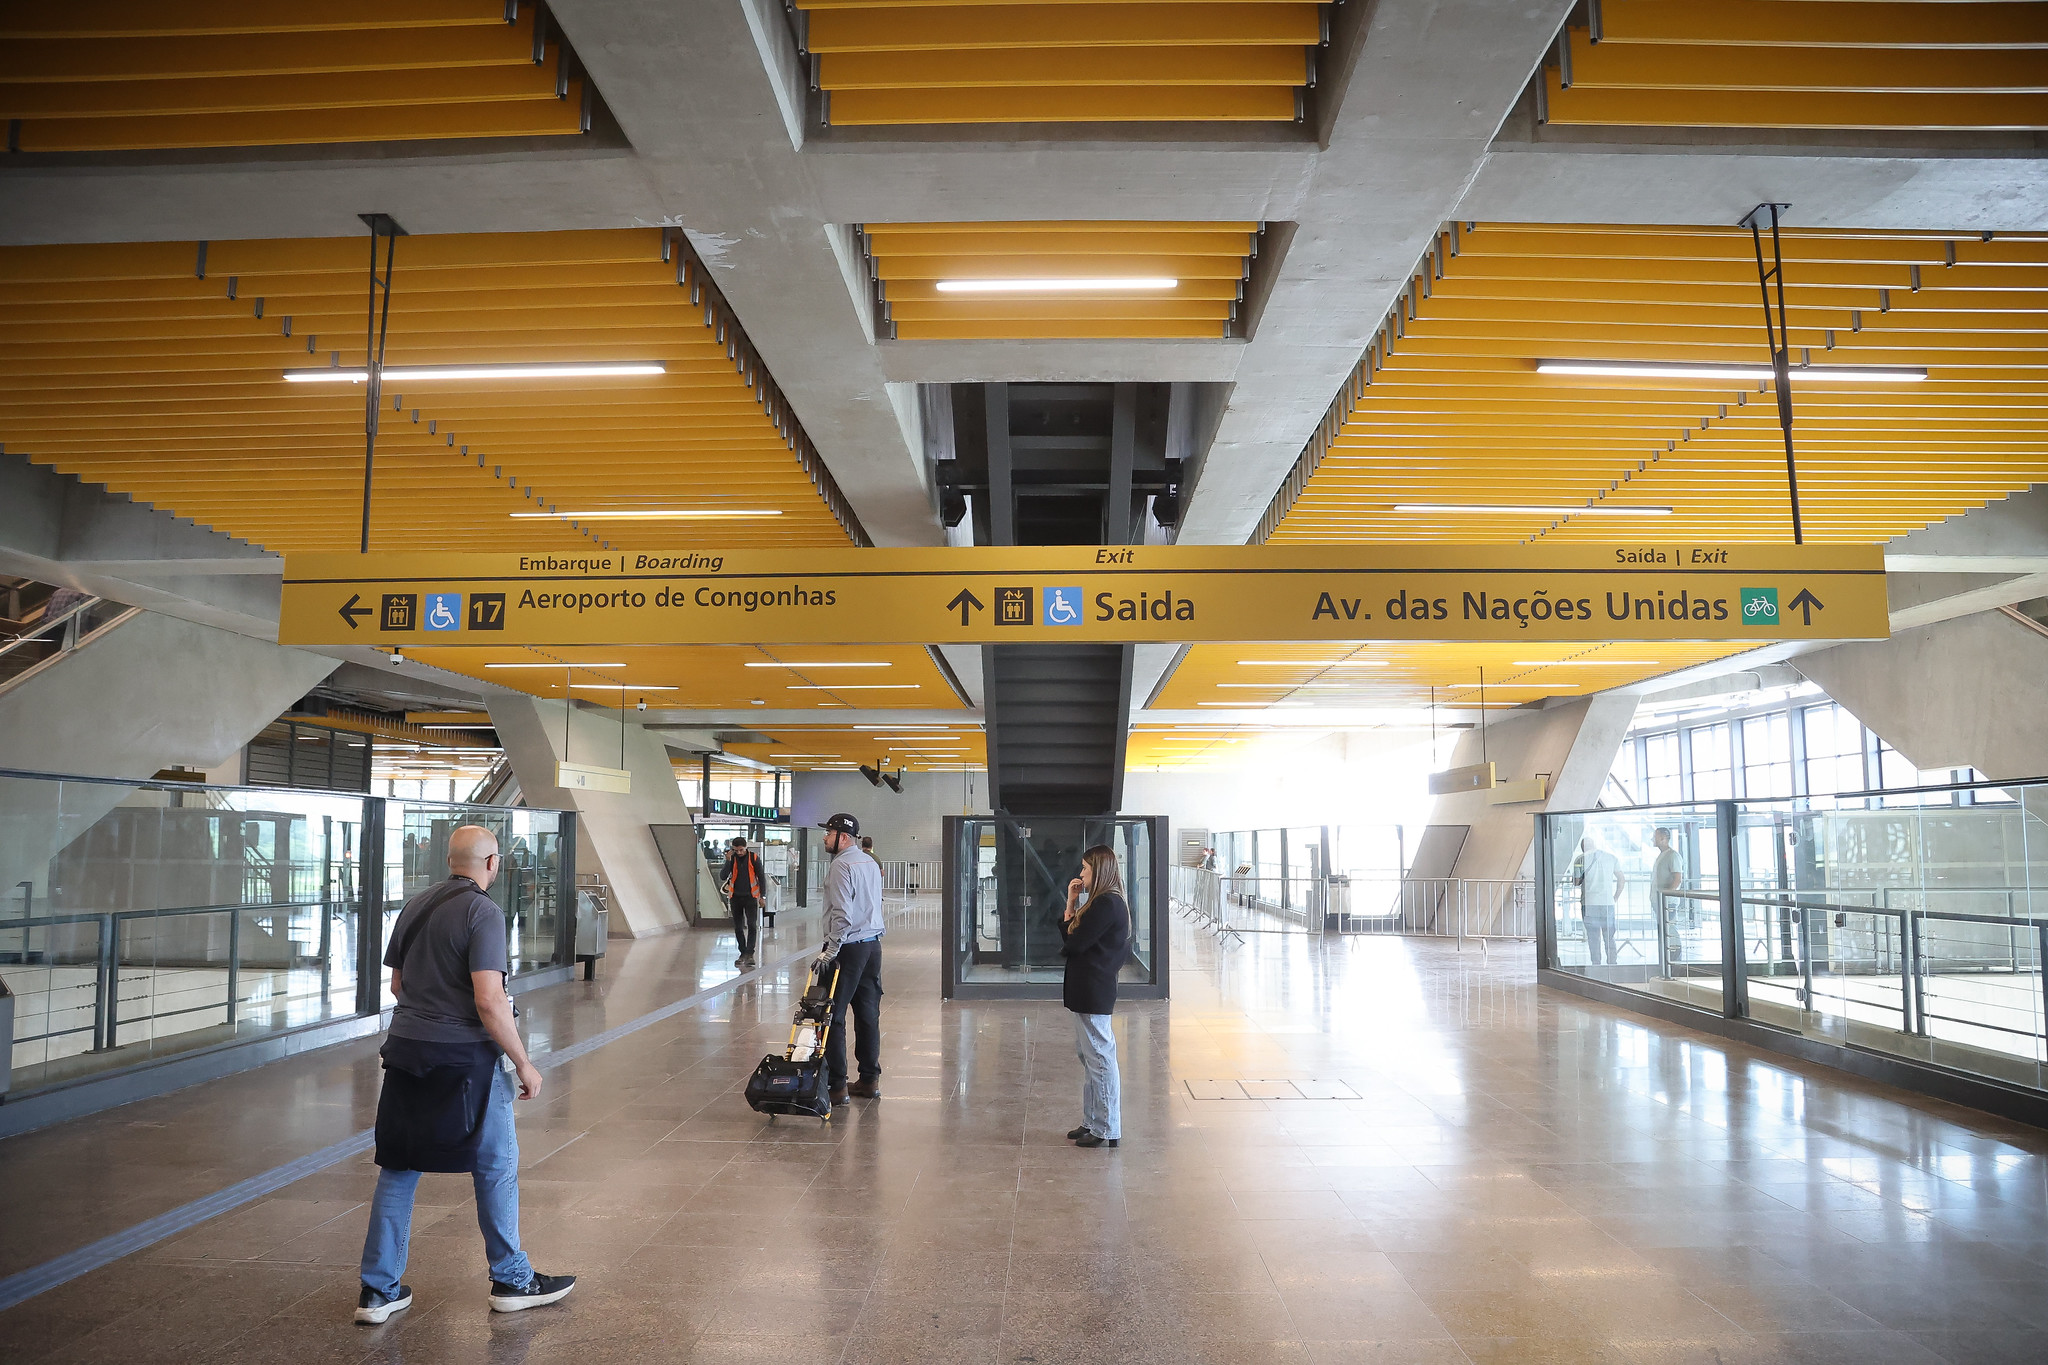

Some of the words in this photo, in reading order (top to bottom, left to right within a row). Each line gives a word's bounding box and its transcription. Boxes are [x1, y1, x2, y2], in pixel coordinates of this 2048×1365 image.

[519, 555, 612, 575] Embarque
[635, 553, 724, 573] Boarding
[1095, 548, 1135, 565] Exit
[1615, 547, 1667, 564] Saída
[1691, 547, 1729, 564] Exit
[518, 588, 646, 614] Aeroporto
[655, 585, 685, 608] de
[694, 584, 837, 613] Congonhas
[1095, 589, 1196, 622] Saida
[1311, 590, 1372, 621] Av.
[1385, 588, 1449, 621] das
[1461, 589, 1593, 630] Nações
[1605, 588, 1729, 622] Unidas
[472, 600, 504, 624] 17
